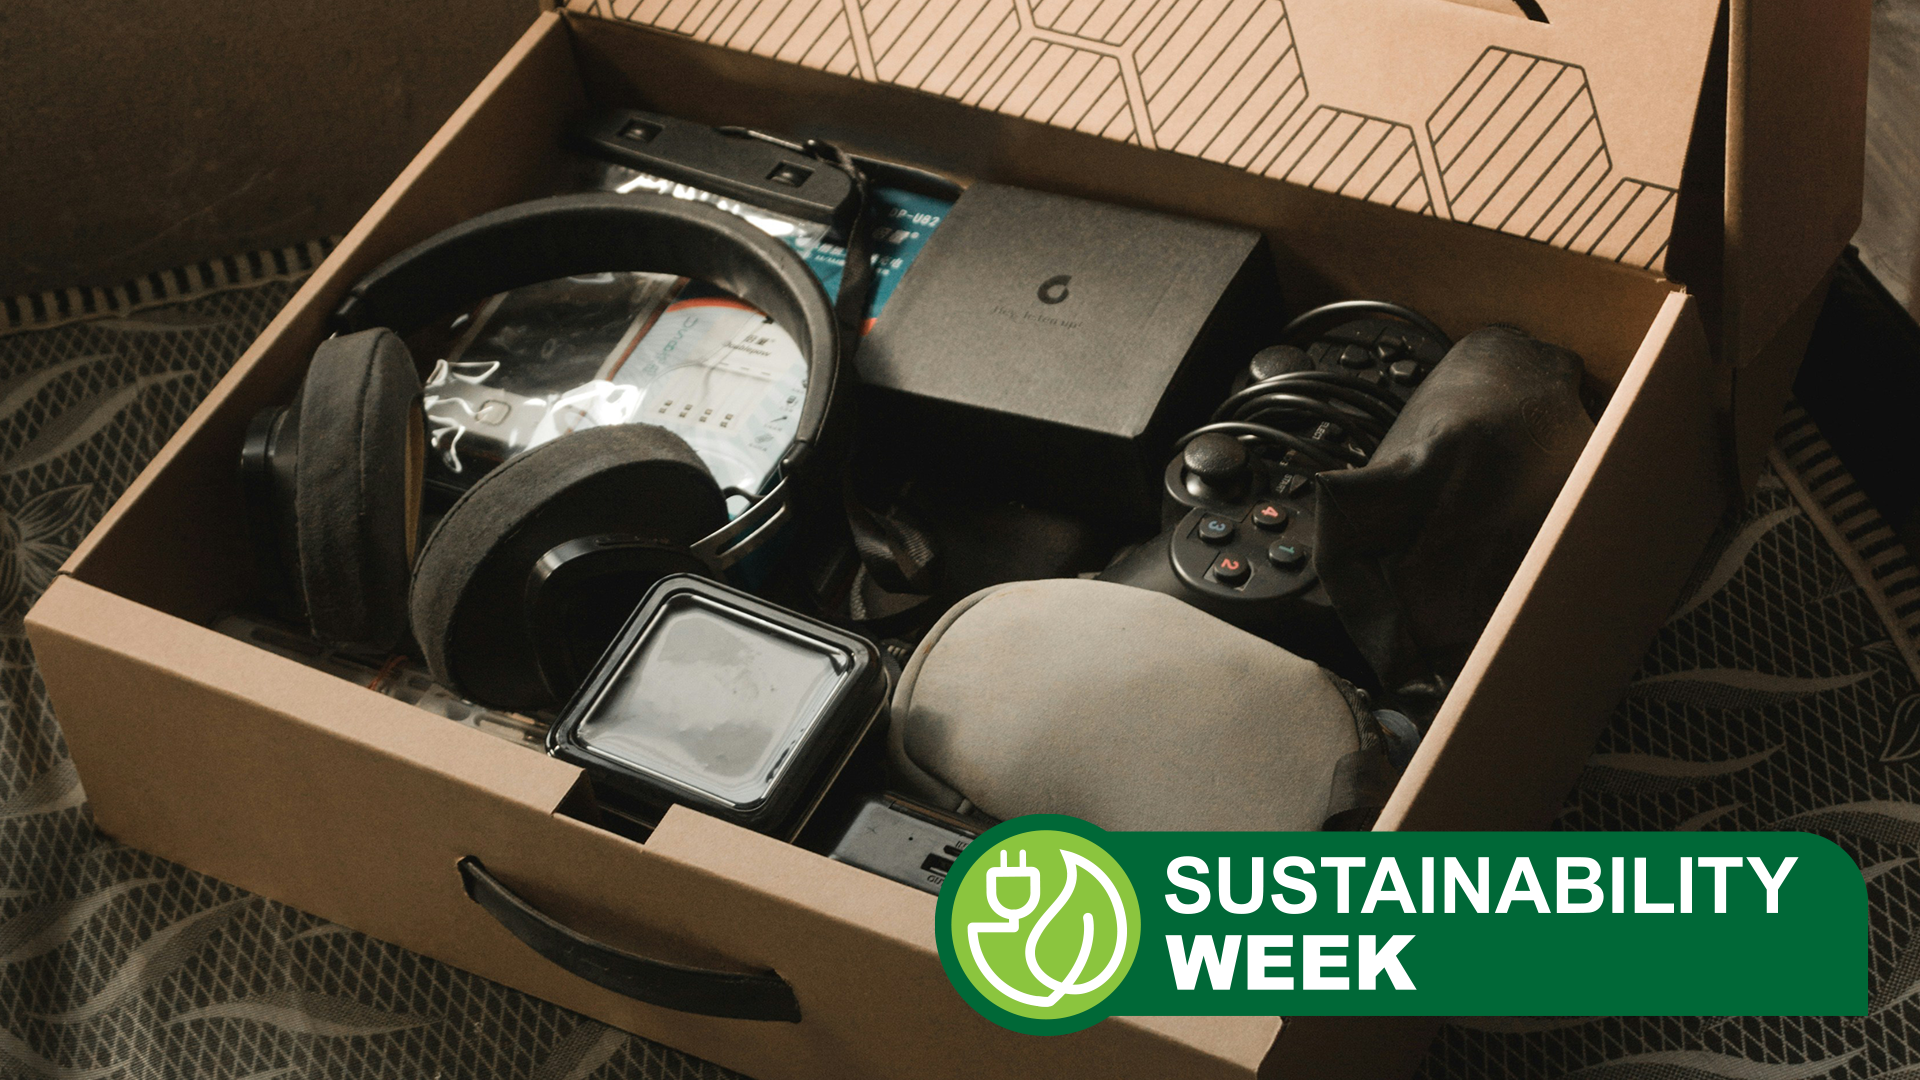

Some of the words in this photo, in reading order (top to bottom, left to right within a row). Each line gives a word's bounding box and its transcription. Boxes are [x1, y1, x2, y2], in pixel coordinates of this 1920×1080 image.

[1261, 506, 1279, 518] 4
[1208, 520, 1226, 532] 3
[1278, 544, 1295, 555] 1
[1221, 558, 1239, 570] 2
